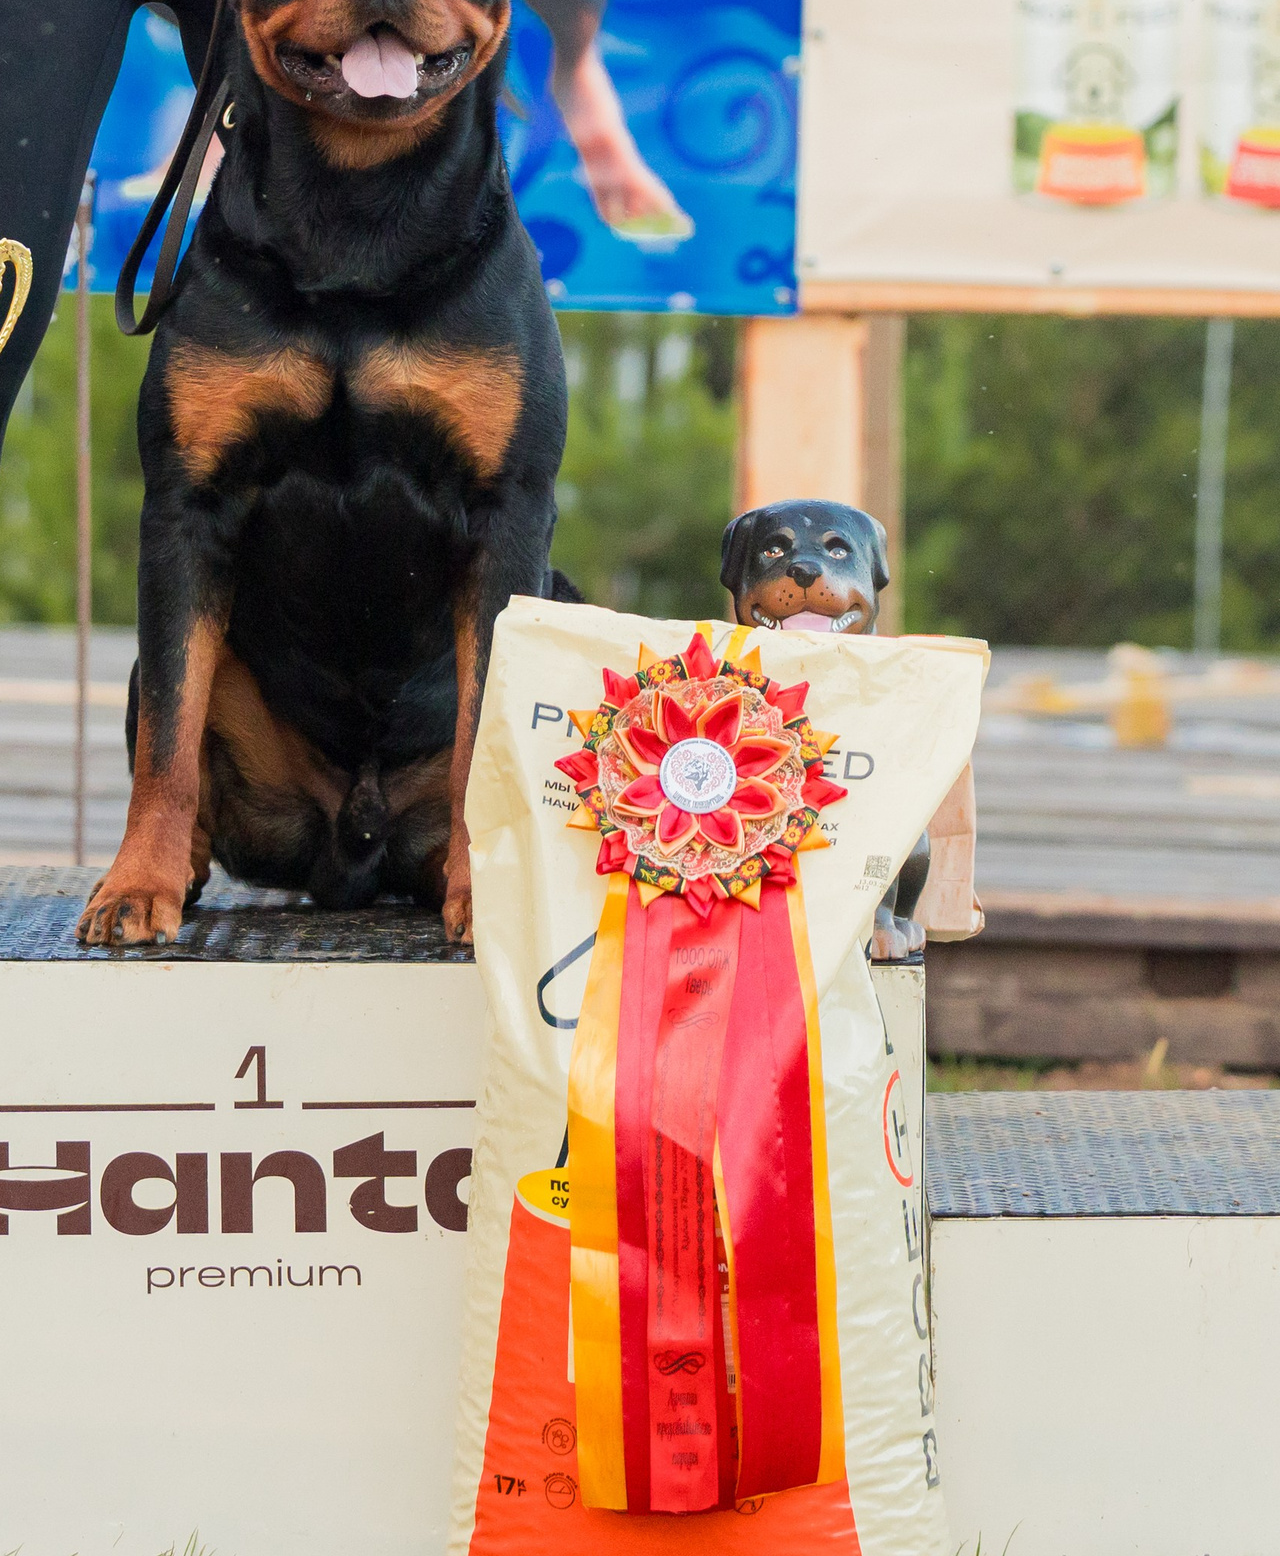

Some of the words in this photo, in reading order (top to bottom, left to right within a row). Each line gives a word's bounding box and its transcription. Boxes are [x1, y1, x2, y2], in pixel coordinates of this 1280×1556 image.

[544, 779, 571, 793] МЫ
[146, 1257, 362, 1294] premium
[494, 1474, 515, 1495] 17
